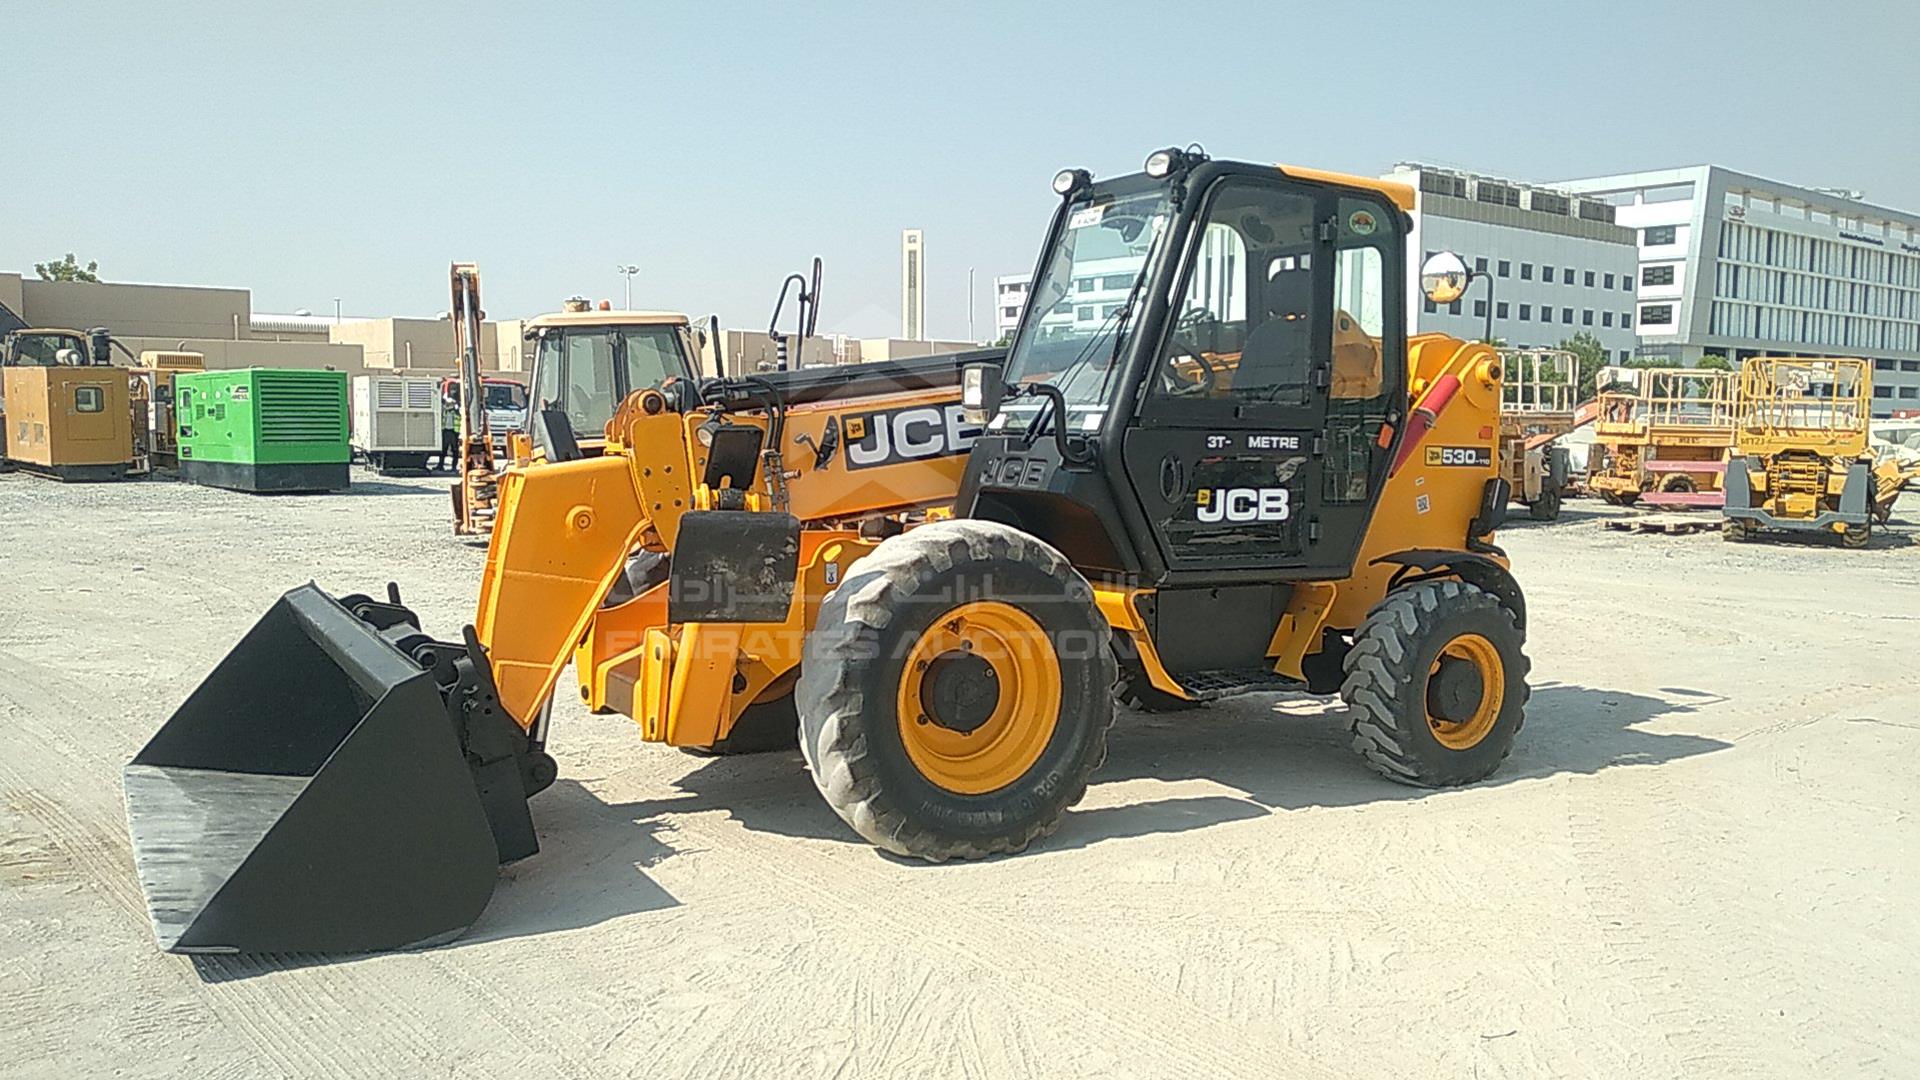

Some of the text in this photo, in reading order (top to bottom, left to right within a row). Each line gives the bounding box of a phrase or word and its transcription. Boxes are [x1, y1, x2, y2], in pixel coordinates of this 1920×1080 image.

[849, 405, 984, 464] JCB
[1248, 435, 1300, 450] METRE
[979, 456, 1048, 488] JCB
[1197, 488, 1290, 522] JCB
